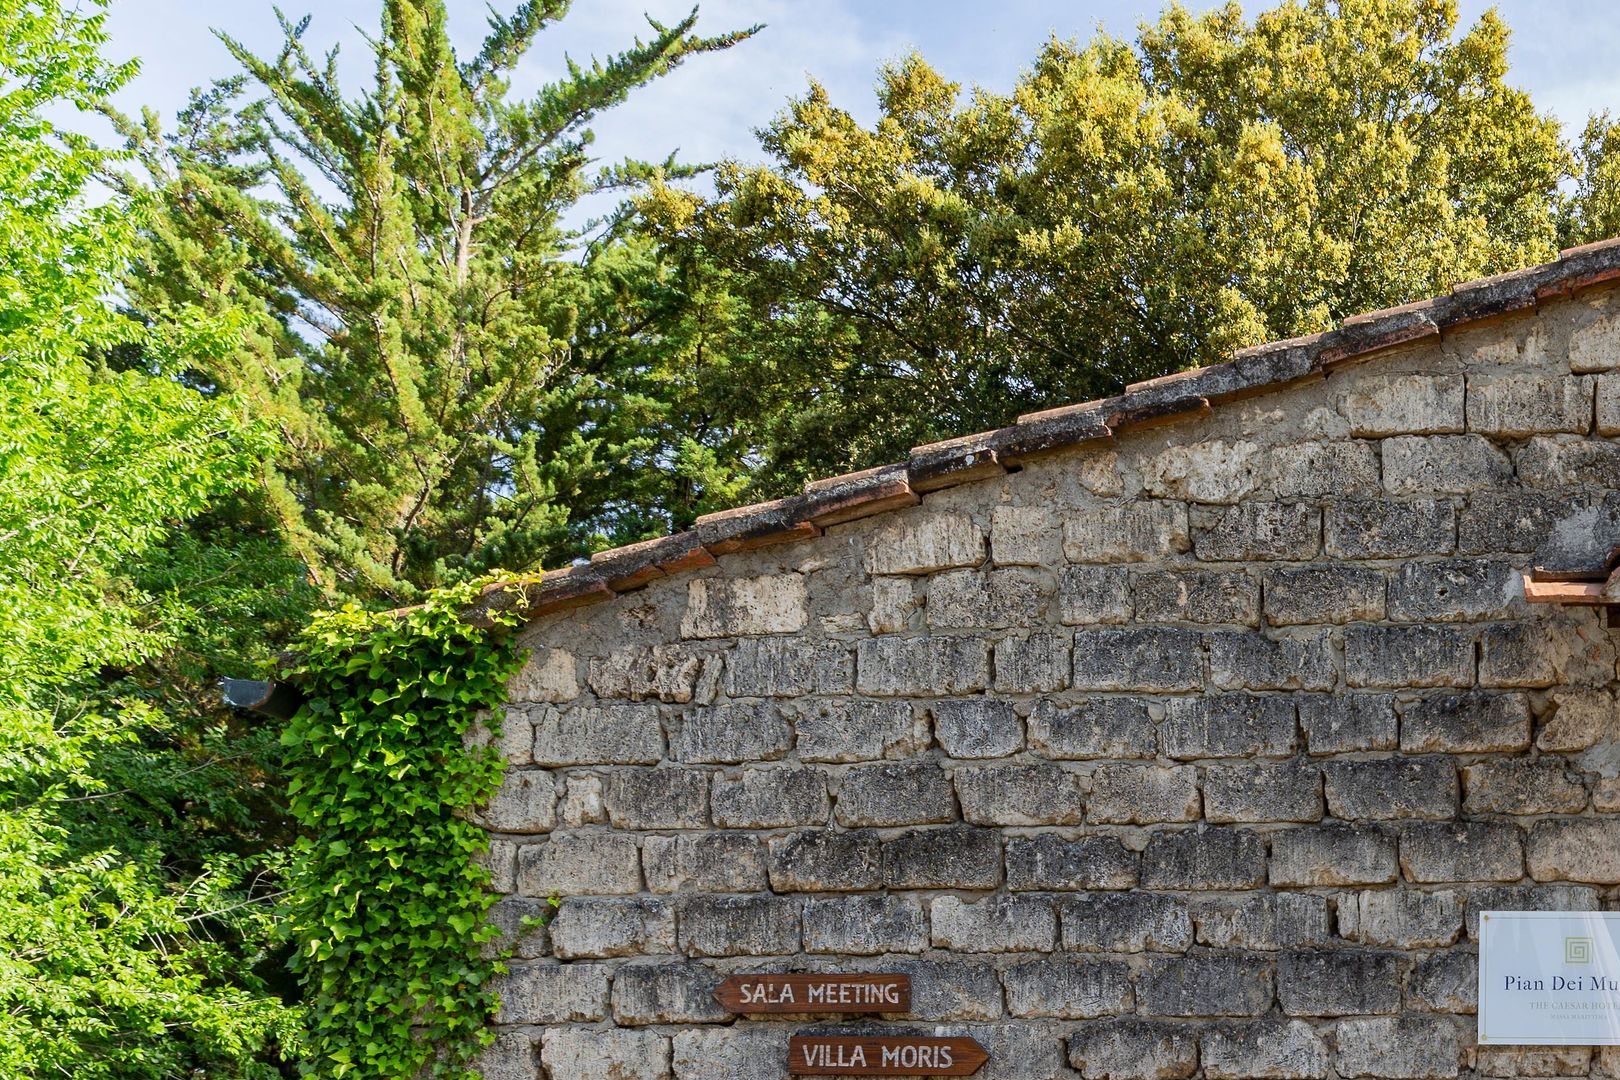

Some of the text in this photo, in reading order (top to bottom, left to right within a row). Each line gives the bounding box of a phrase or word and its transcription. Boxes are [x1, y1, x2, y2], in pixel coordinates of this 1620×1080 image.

[1504, 976, 1544, 991] Pian
[1552, 976, 1582, 991] Dei
[739, 983, 899, 1004] SALA MEETING
[1529, 1001, 1548, 1010] THE
[1551, 1001, 1589, 1010] CAESAR
[802, 1044, 953, 1069] VILLA MORIS
